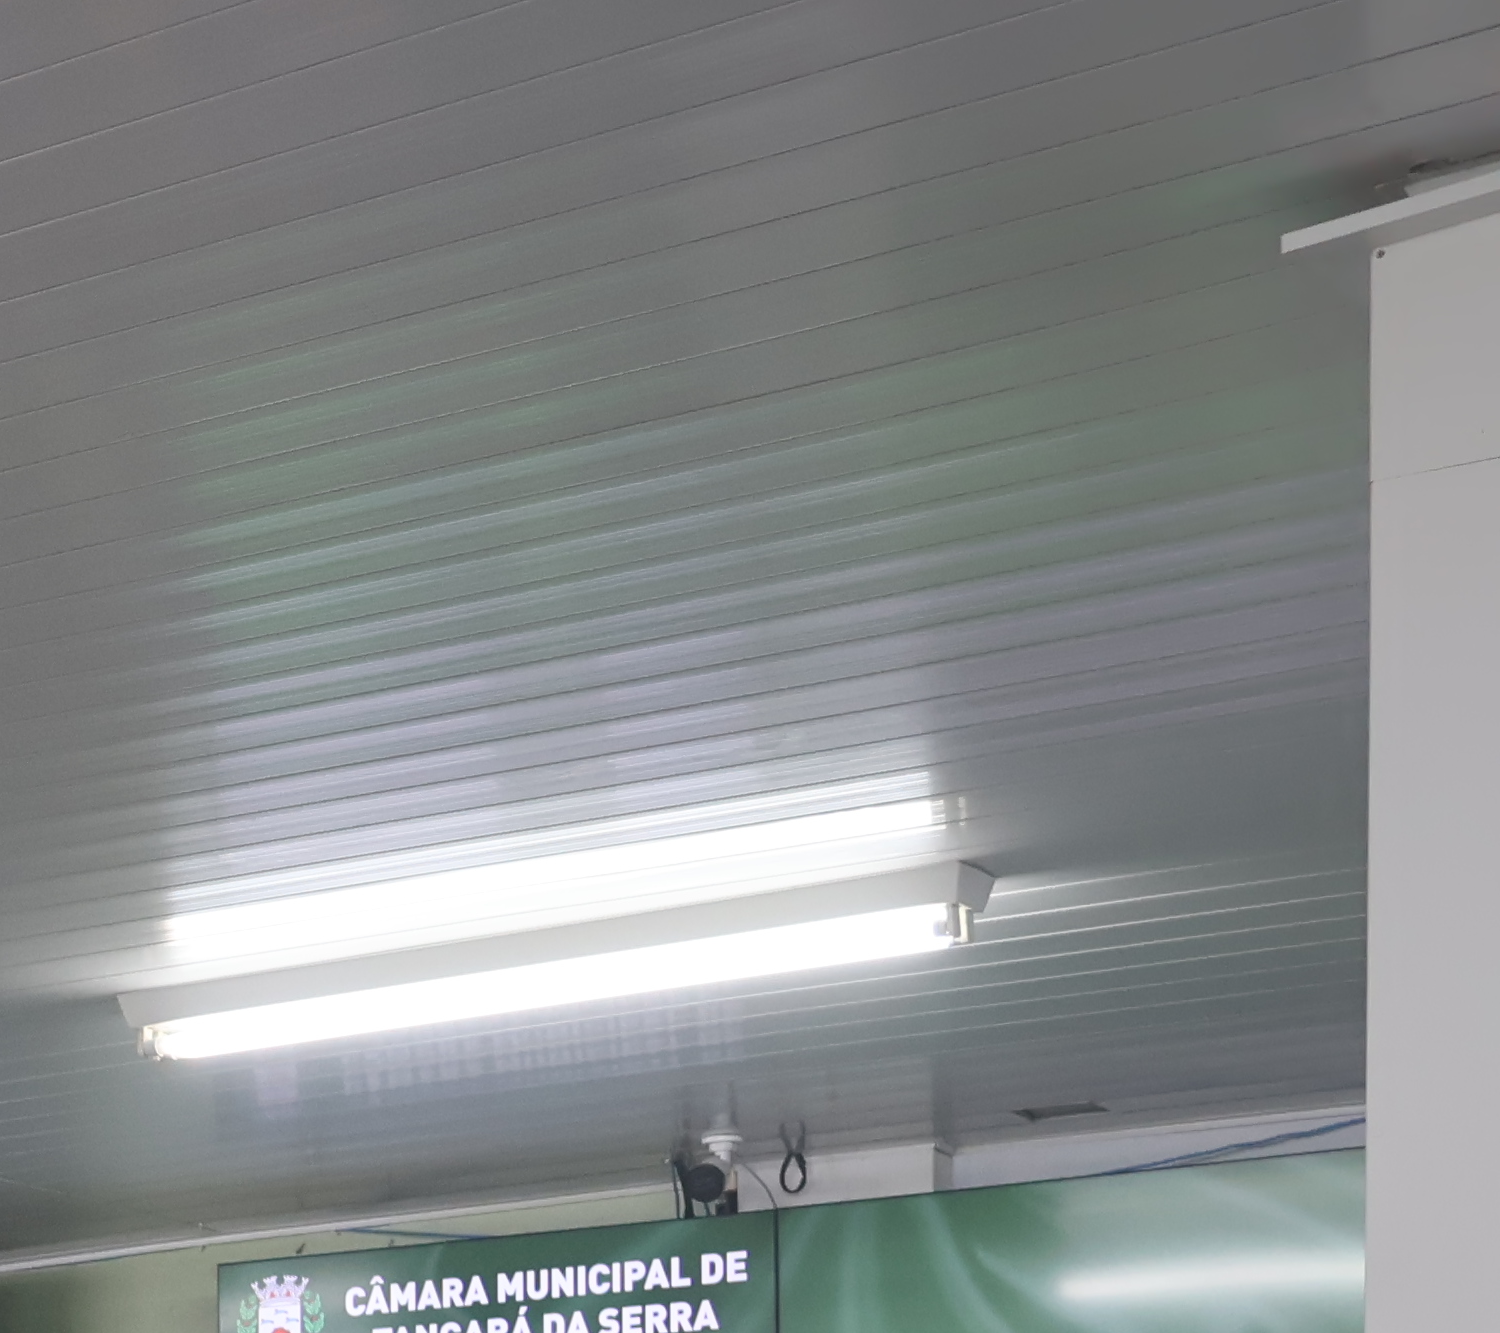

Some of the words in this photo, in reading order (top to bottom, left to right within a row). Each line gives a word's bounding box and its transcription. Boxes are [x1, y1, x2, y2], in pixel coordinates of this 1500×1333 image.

[344, 1275, 489, 1317] CÂMARA
[497, 1257, 691, 1303] MUNICIPAL
[700, 1250, 748, 1286] DE
